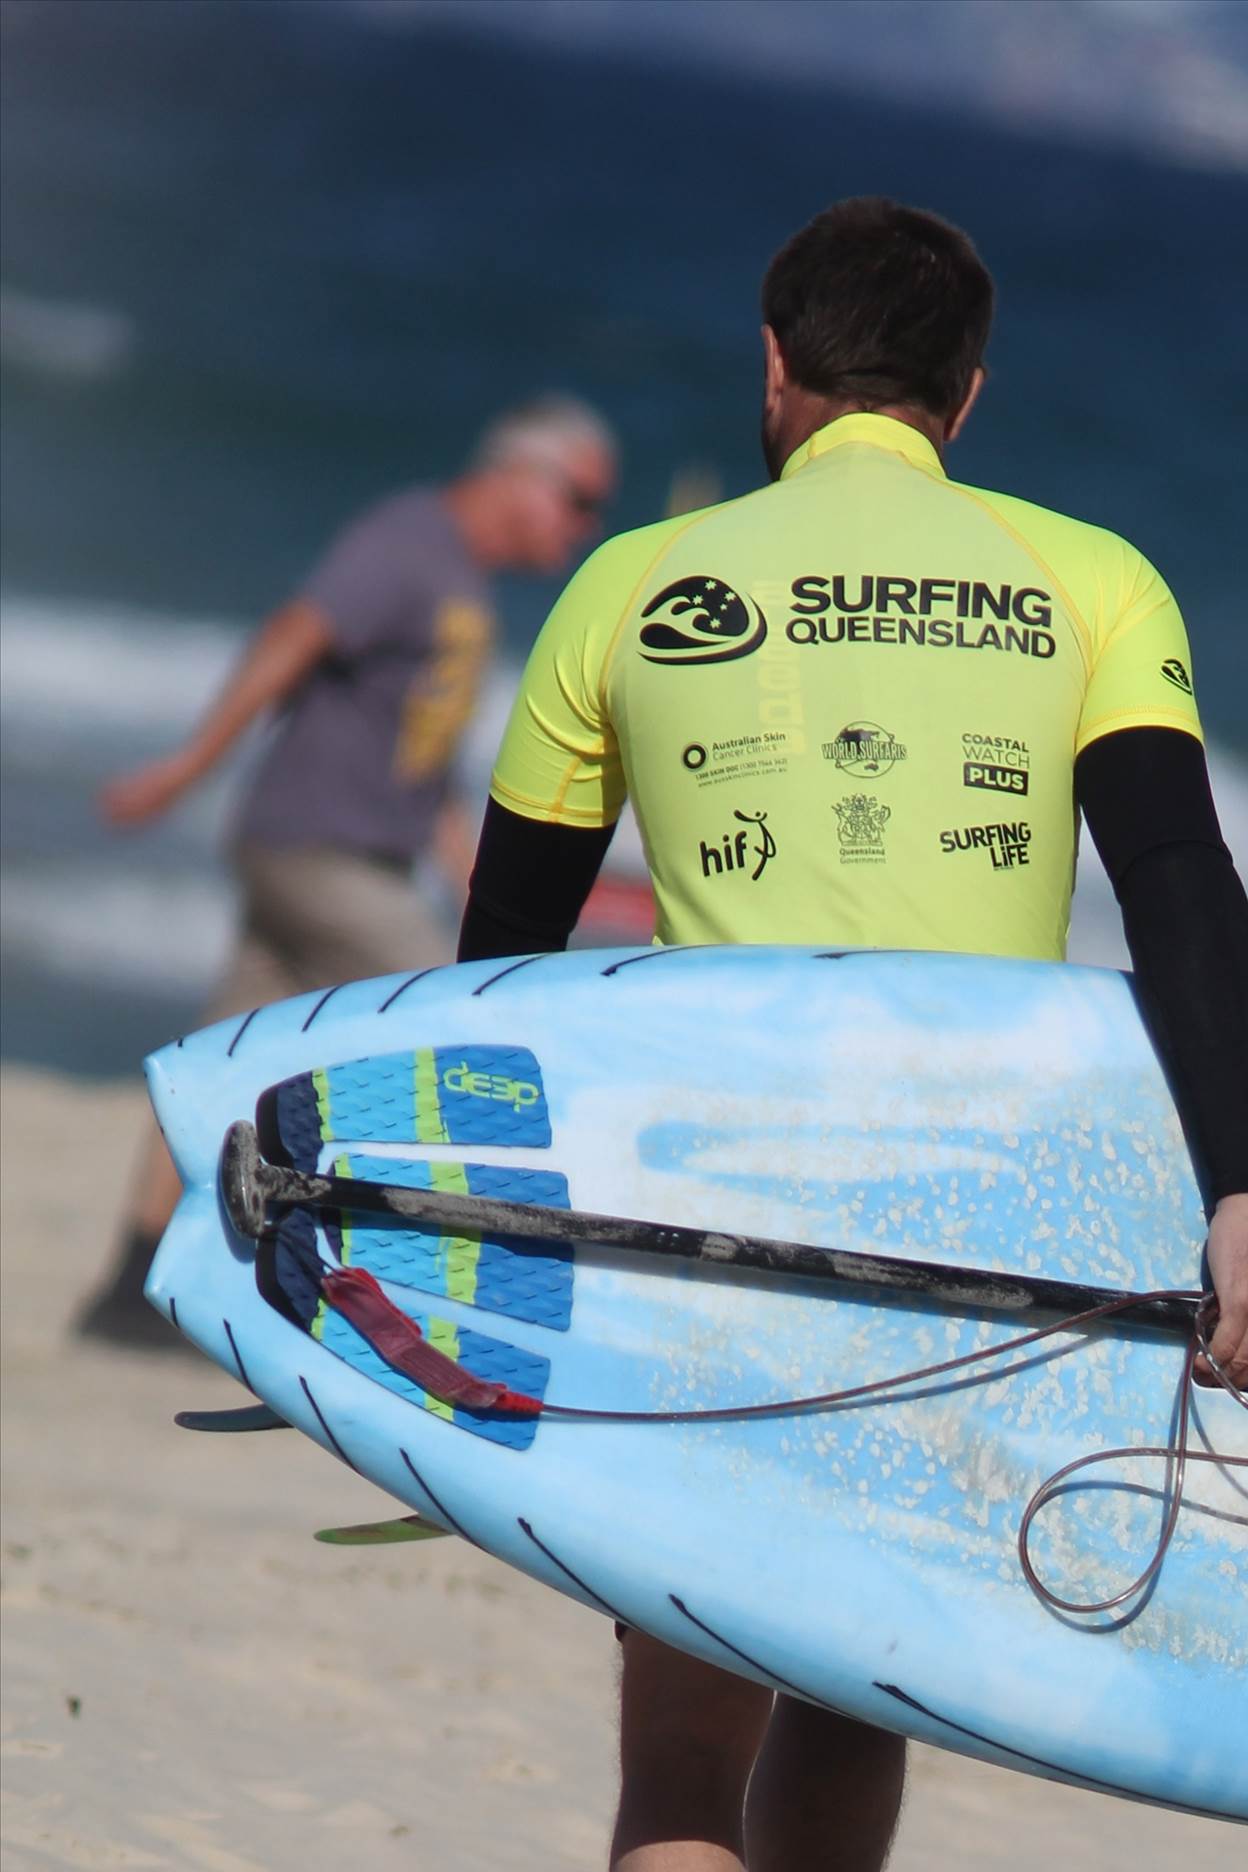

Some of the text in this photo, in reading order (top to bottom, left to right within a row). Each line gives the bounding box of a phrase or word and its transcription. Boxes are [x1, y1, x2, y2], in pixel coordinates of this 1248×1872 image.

[790, 574, 1052, 629] SURFING
[785, 616, 1057, 660] QUEENSLAND
[712, 731, 786, 751] Australian Skin
[712, 743, 777, 761] Cancer Clinics
[821, 740, 906, 761] WORLD SURFARIS
[961, 733, 1030, 753] COASTAL
[962, 745, 1030, 769] WATCH
[969, 766, 1025, 790] PLUS
[940, 822, 1032, 853] SURFING
[700, 830, 748, 877] hif
[839, 847, 886, 856] Queensland
[839, 857, 887, 865] Government
